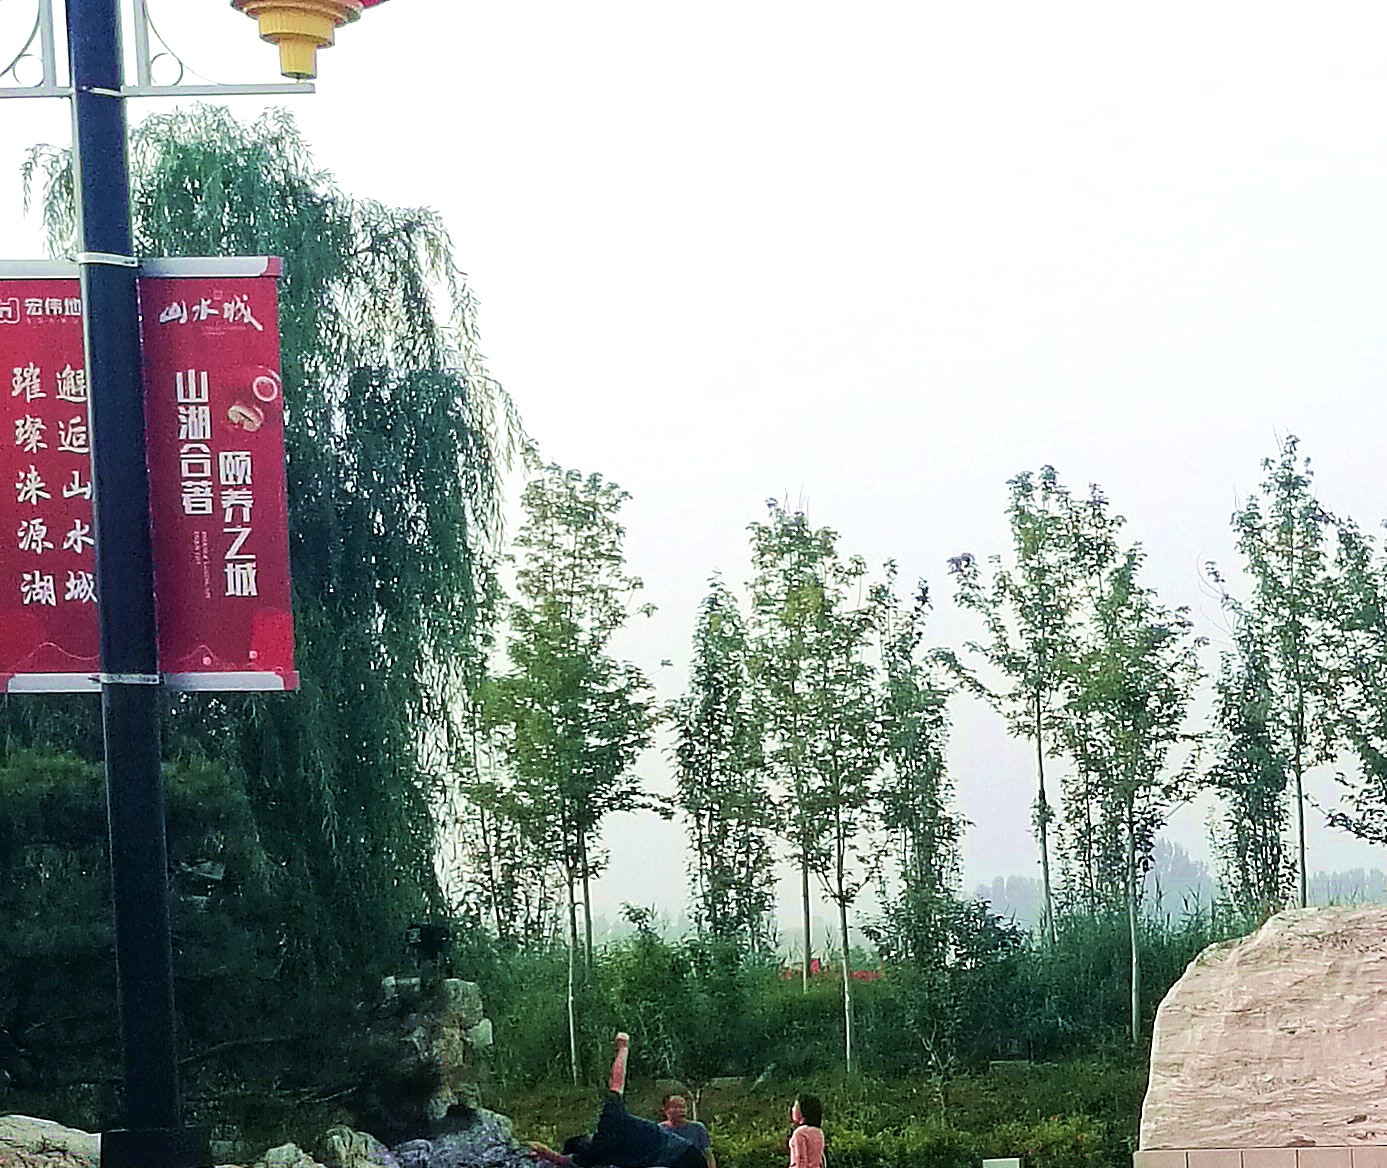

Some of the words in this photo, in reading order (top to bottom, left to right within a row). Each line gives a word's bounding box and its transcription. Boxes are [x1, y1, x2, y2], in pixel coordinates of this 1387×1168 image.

[159, 294, 263, 331] 山水城
[11, 361, 57, 606] 璀璨涞源湖
[55, 363, 98, 603] 邂逅山水城
[175, 369, 214, 515] 山湖合著
[218, 451, 258, 597] 颐养之城
